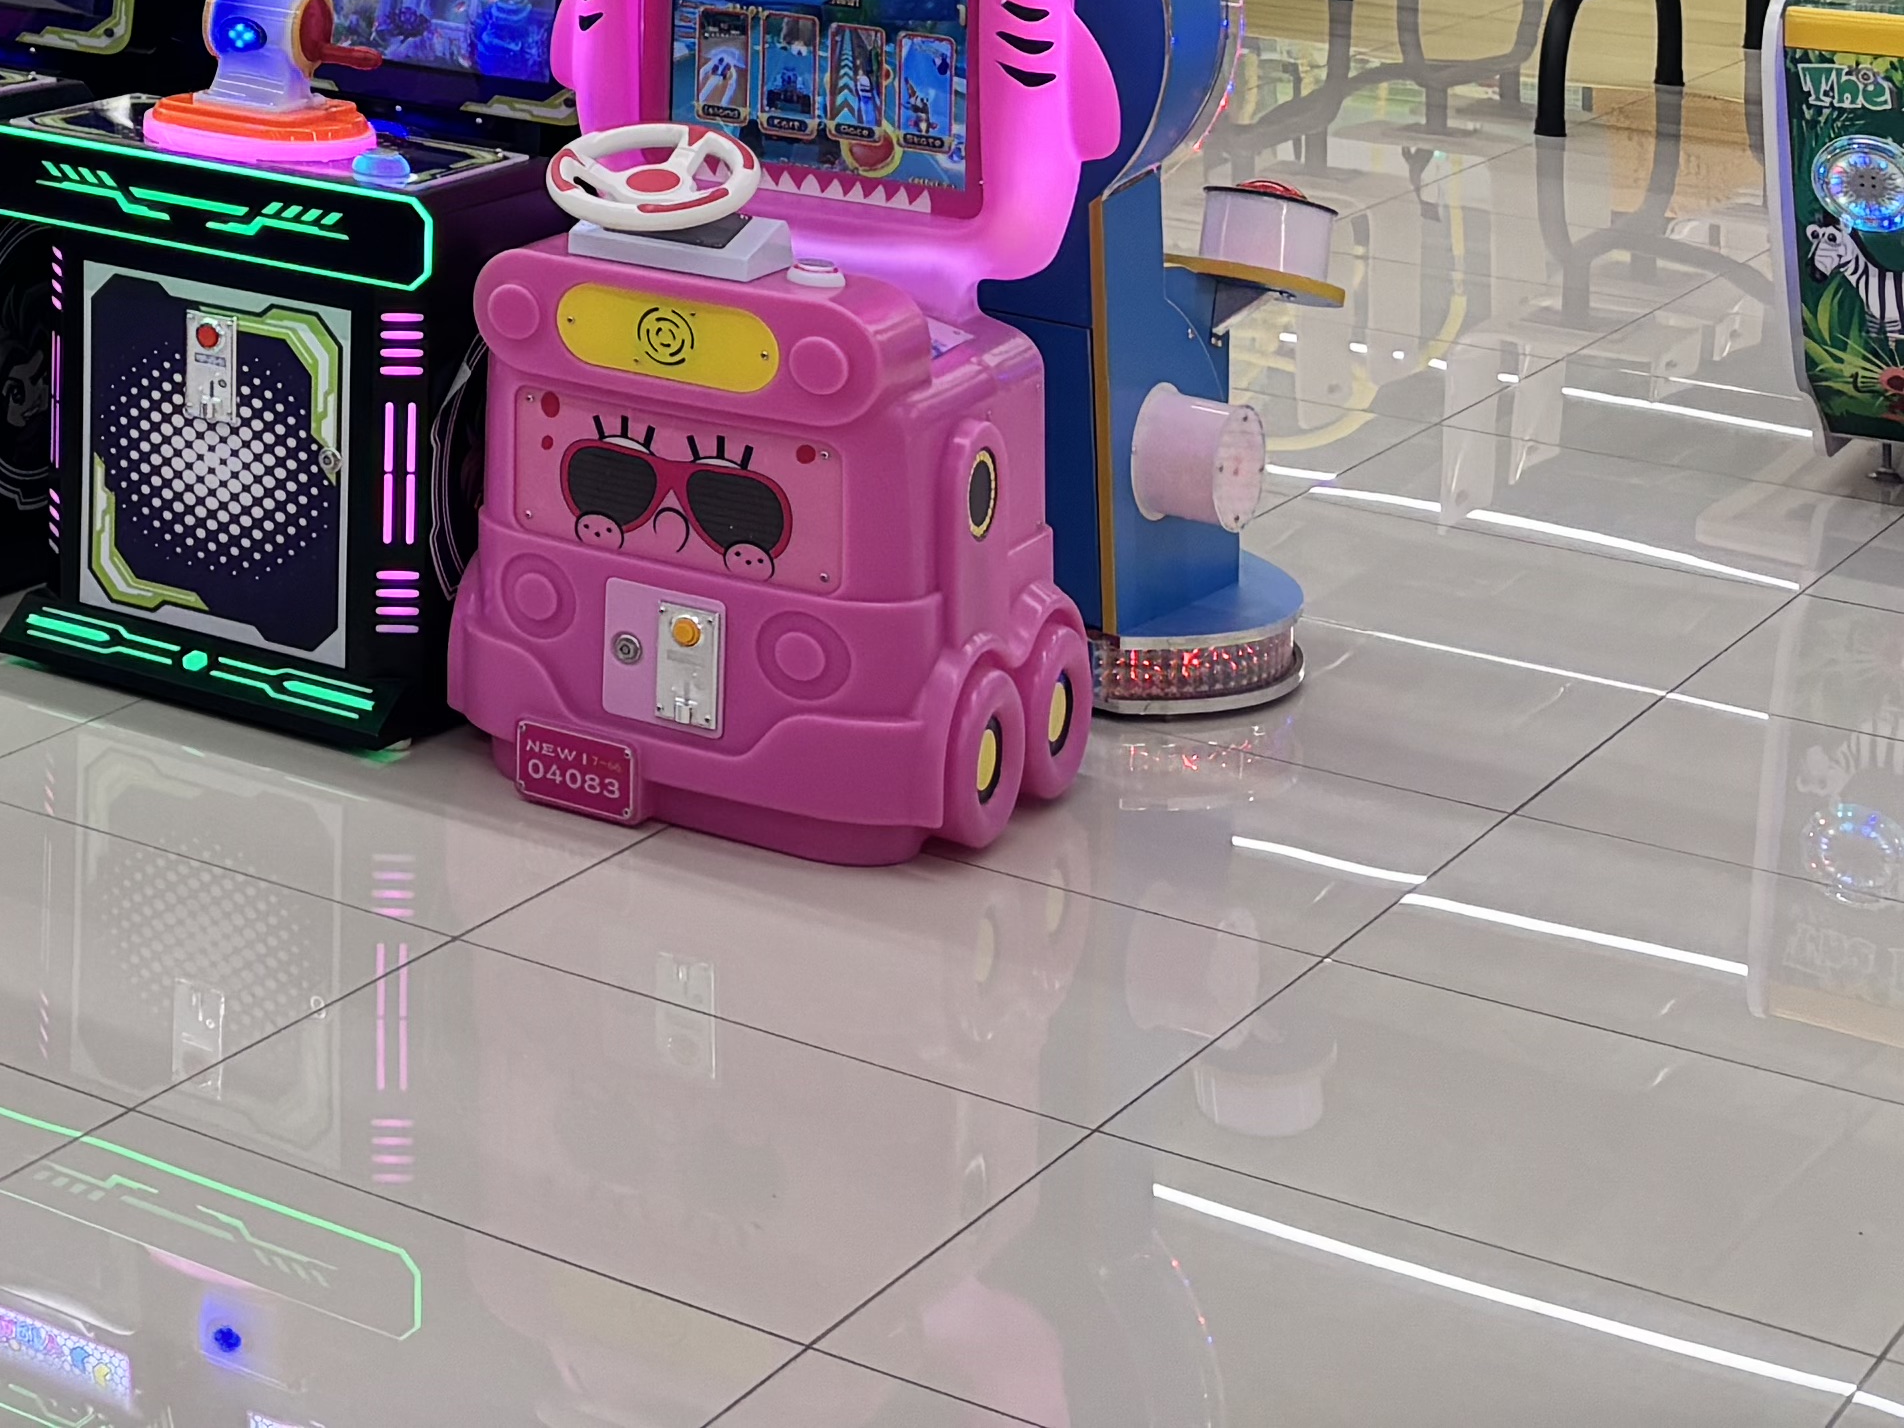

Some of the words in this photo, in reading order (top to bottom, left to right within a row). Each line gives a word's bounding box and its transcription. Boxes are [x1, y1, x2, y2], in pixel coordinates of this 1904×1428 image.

[1797, 63, 1892, 111] The
[525, 739, 577, 762] NEW
[527, 758, 621, 799] 04083
